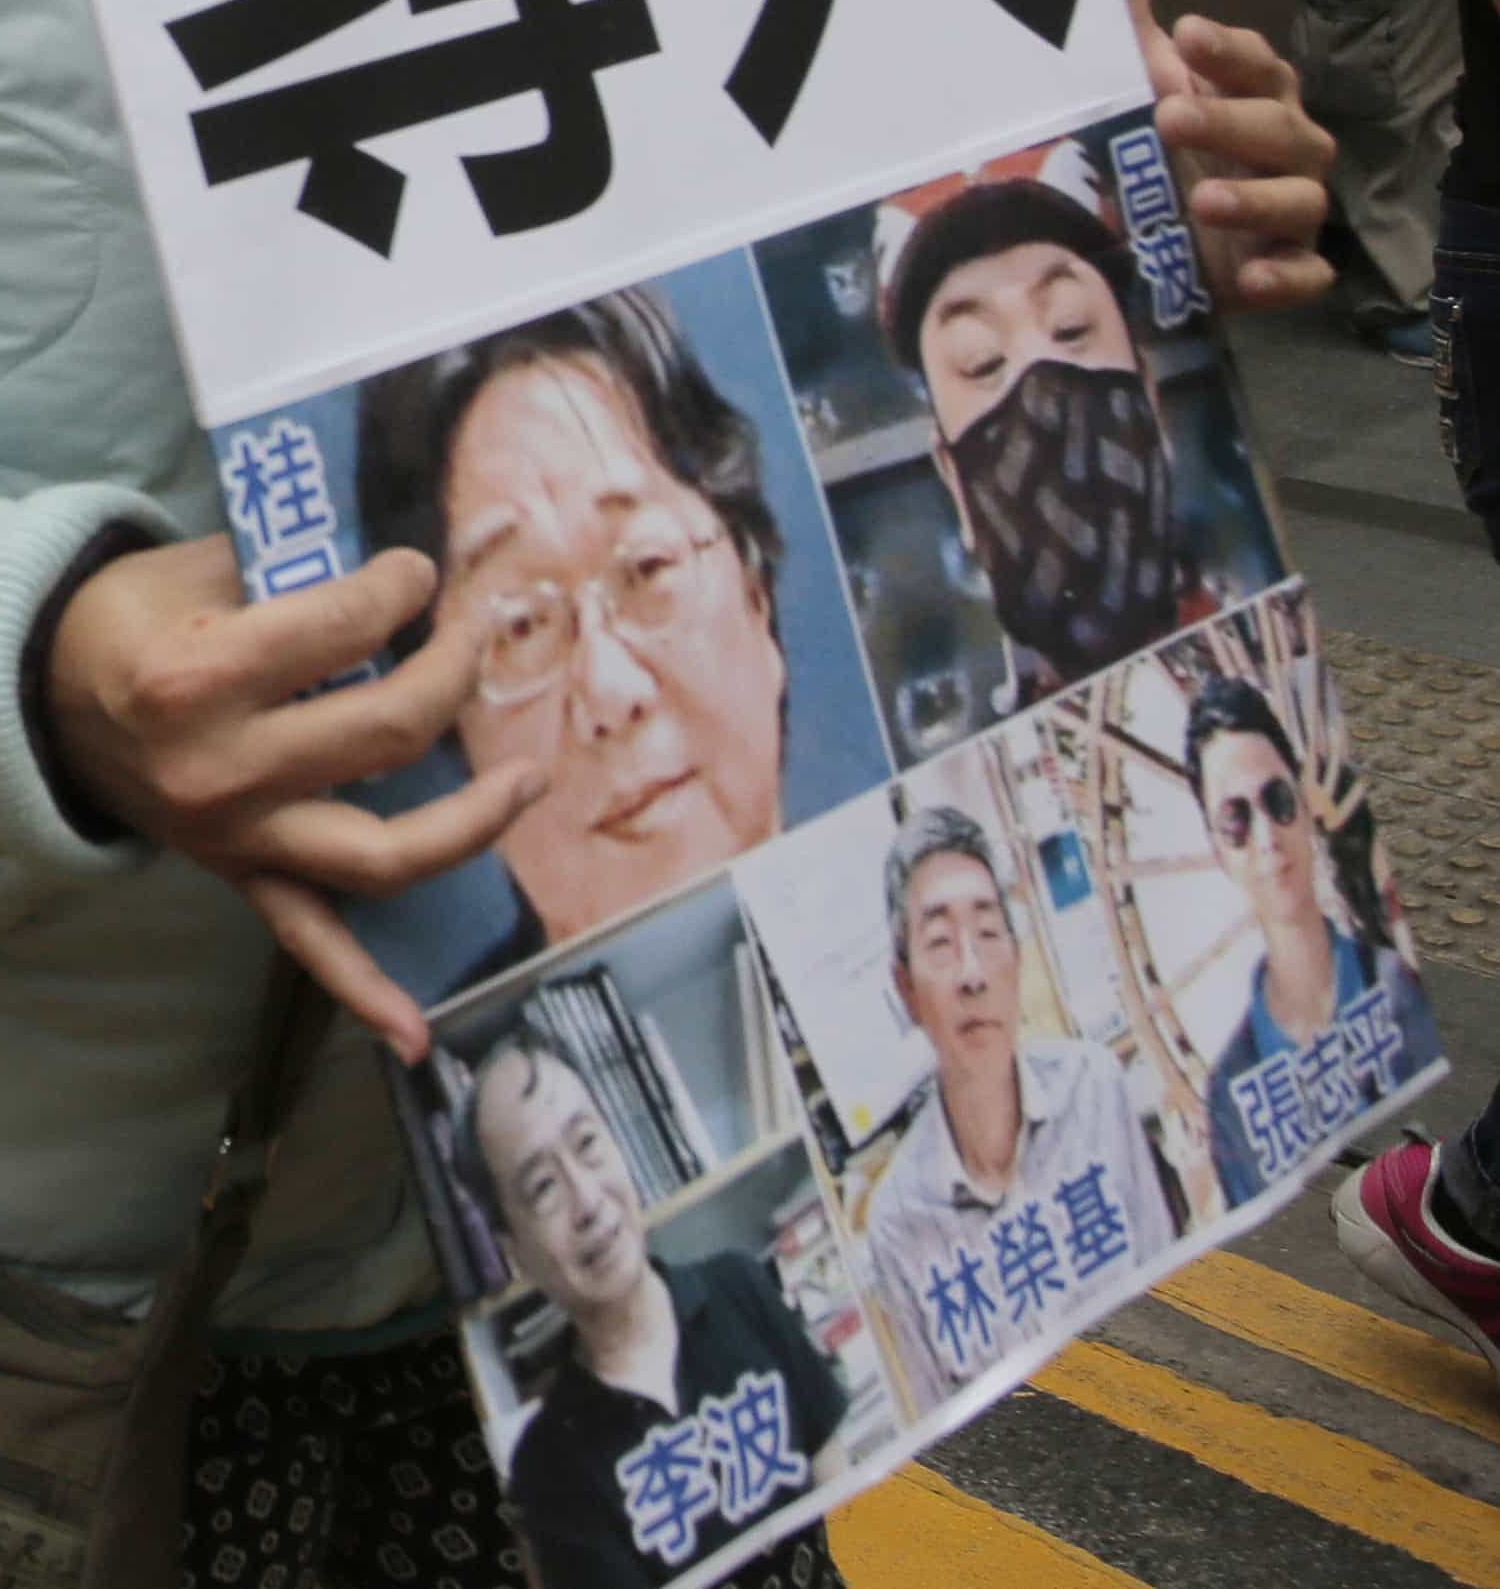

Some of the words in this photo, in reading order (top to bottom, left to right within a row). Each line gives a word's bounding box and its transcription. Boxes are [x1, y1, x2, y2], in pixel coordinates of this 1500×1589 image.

[1236, 989, 1398, 1172] 張志平
[925, 1163, 1129, 1362] 林榮基
[624, 1383, 800, 1552] 李波
